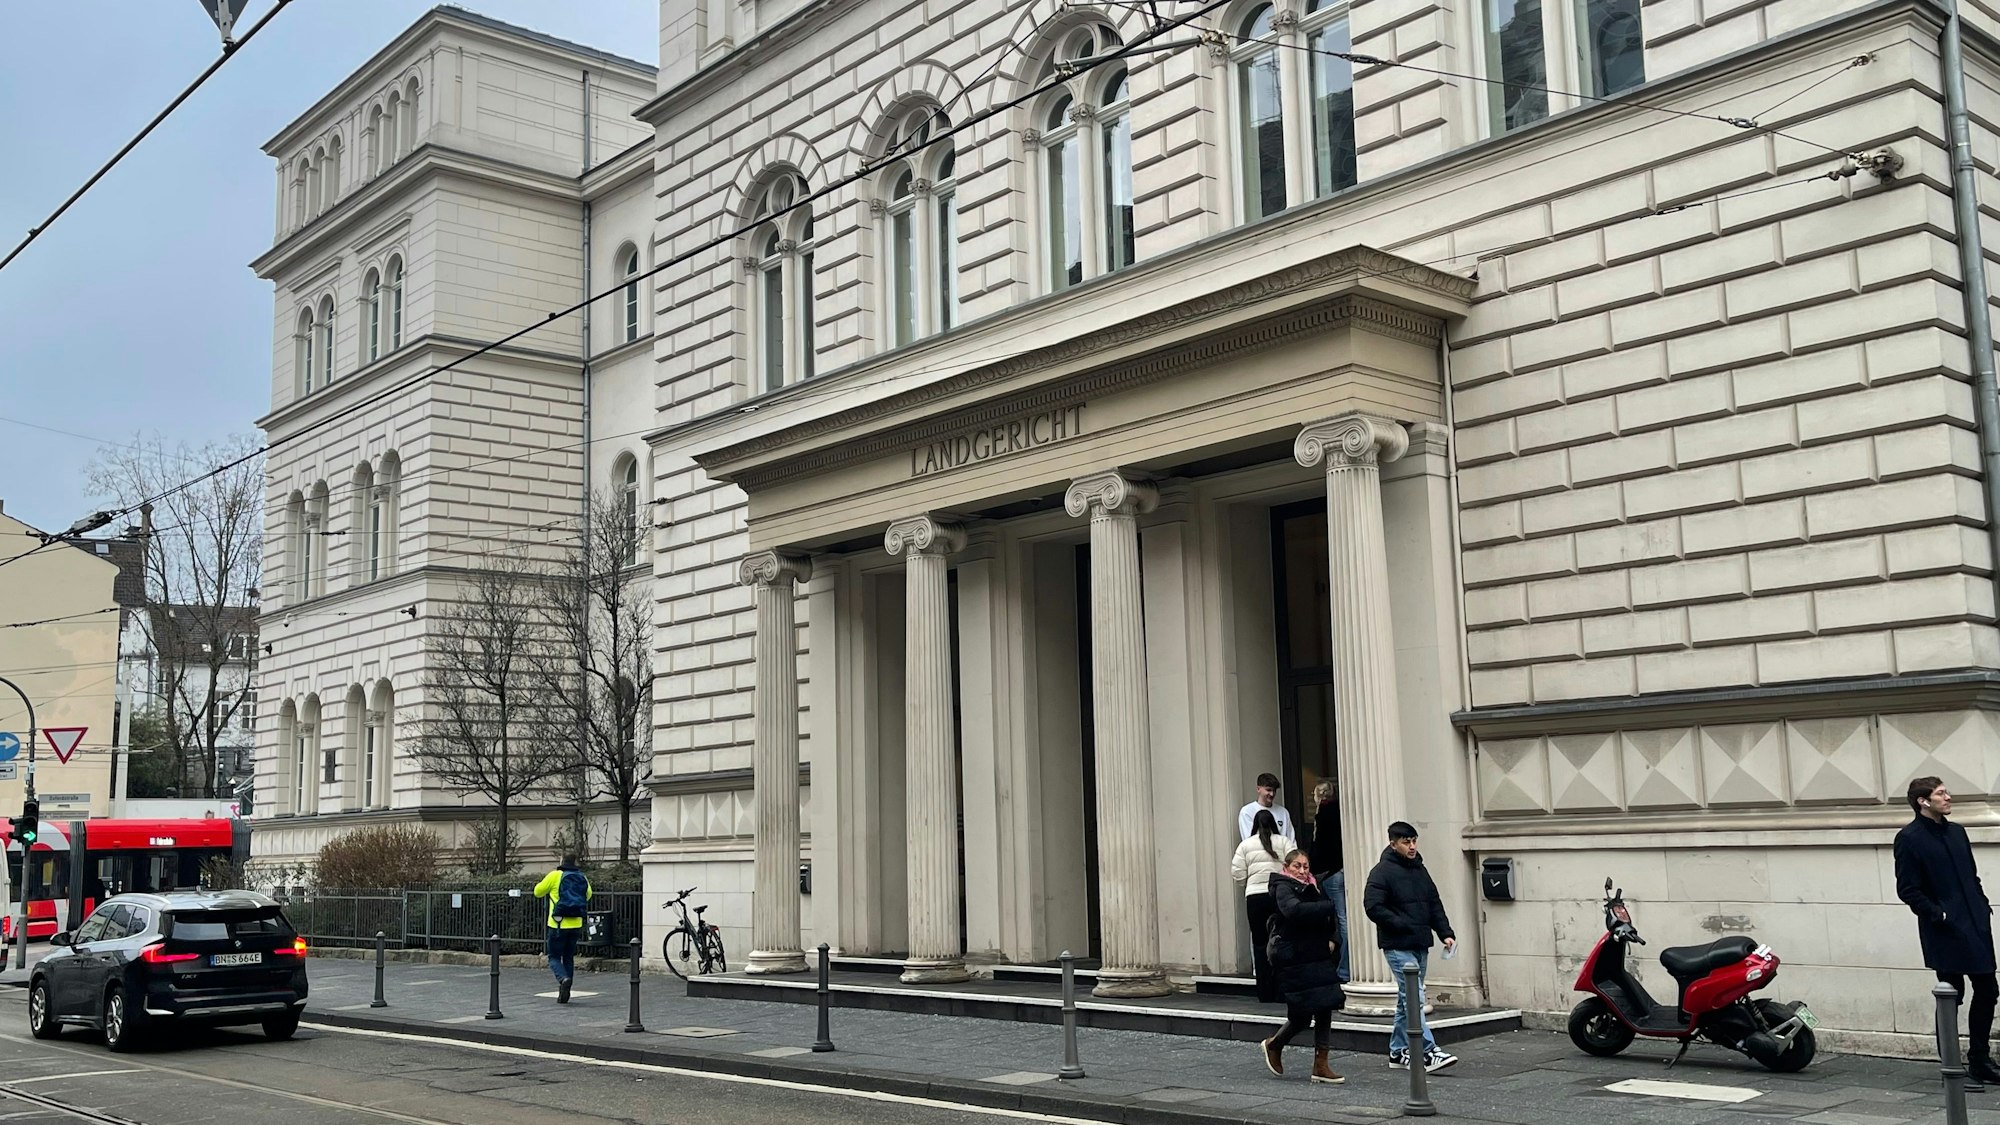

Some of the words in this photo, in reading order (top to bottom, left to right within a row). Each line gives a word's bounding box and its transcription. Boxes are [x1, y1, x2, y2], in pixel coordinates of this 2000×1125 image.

[911, 403, 1086, 477] LANDGERICHT
[215, 955, 226, 964] BN
[231, 954, 237, 963] S
[238, 953, 260, 963] 664E
